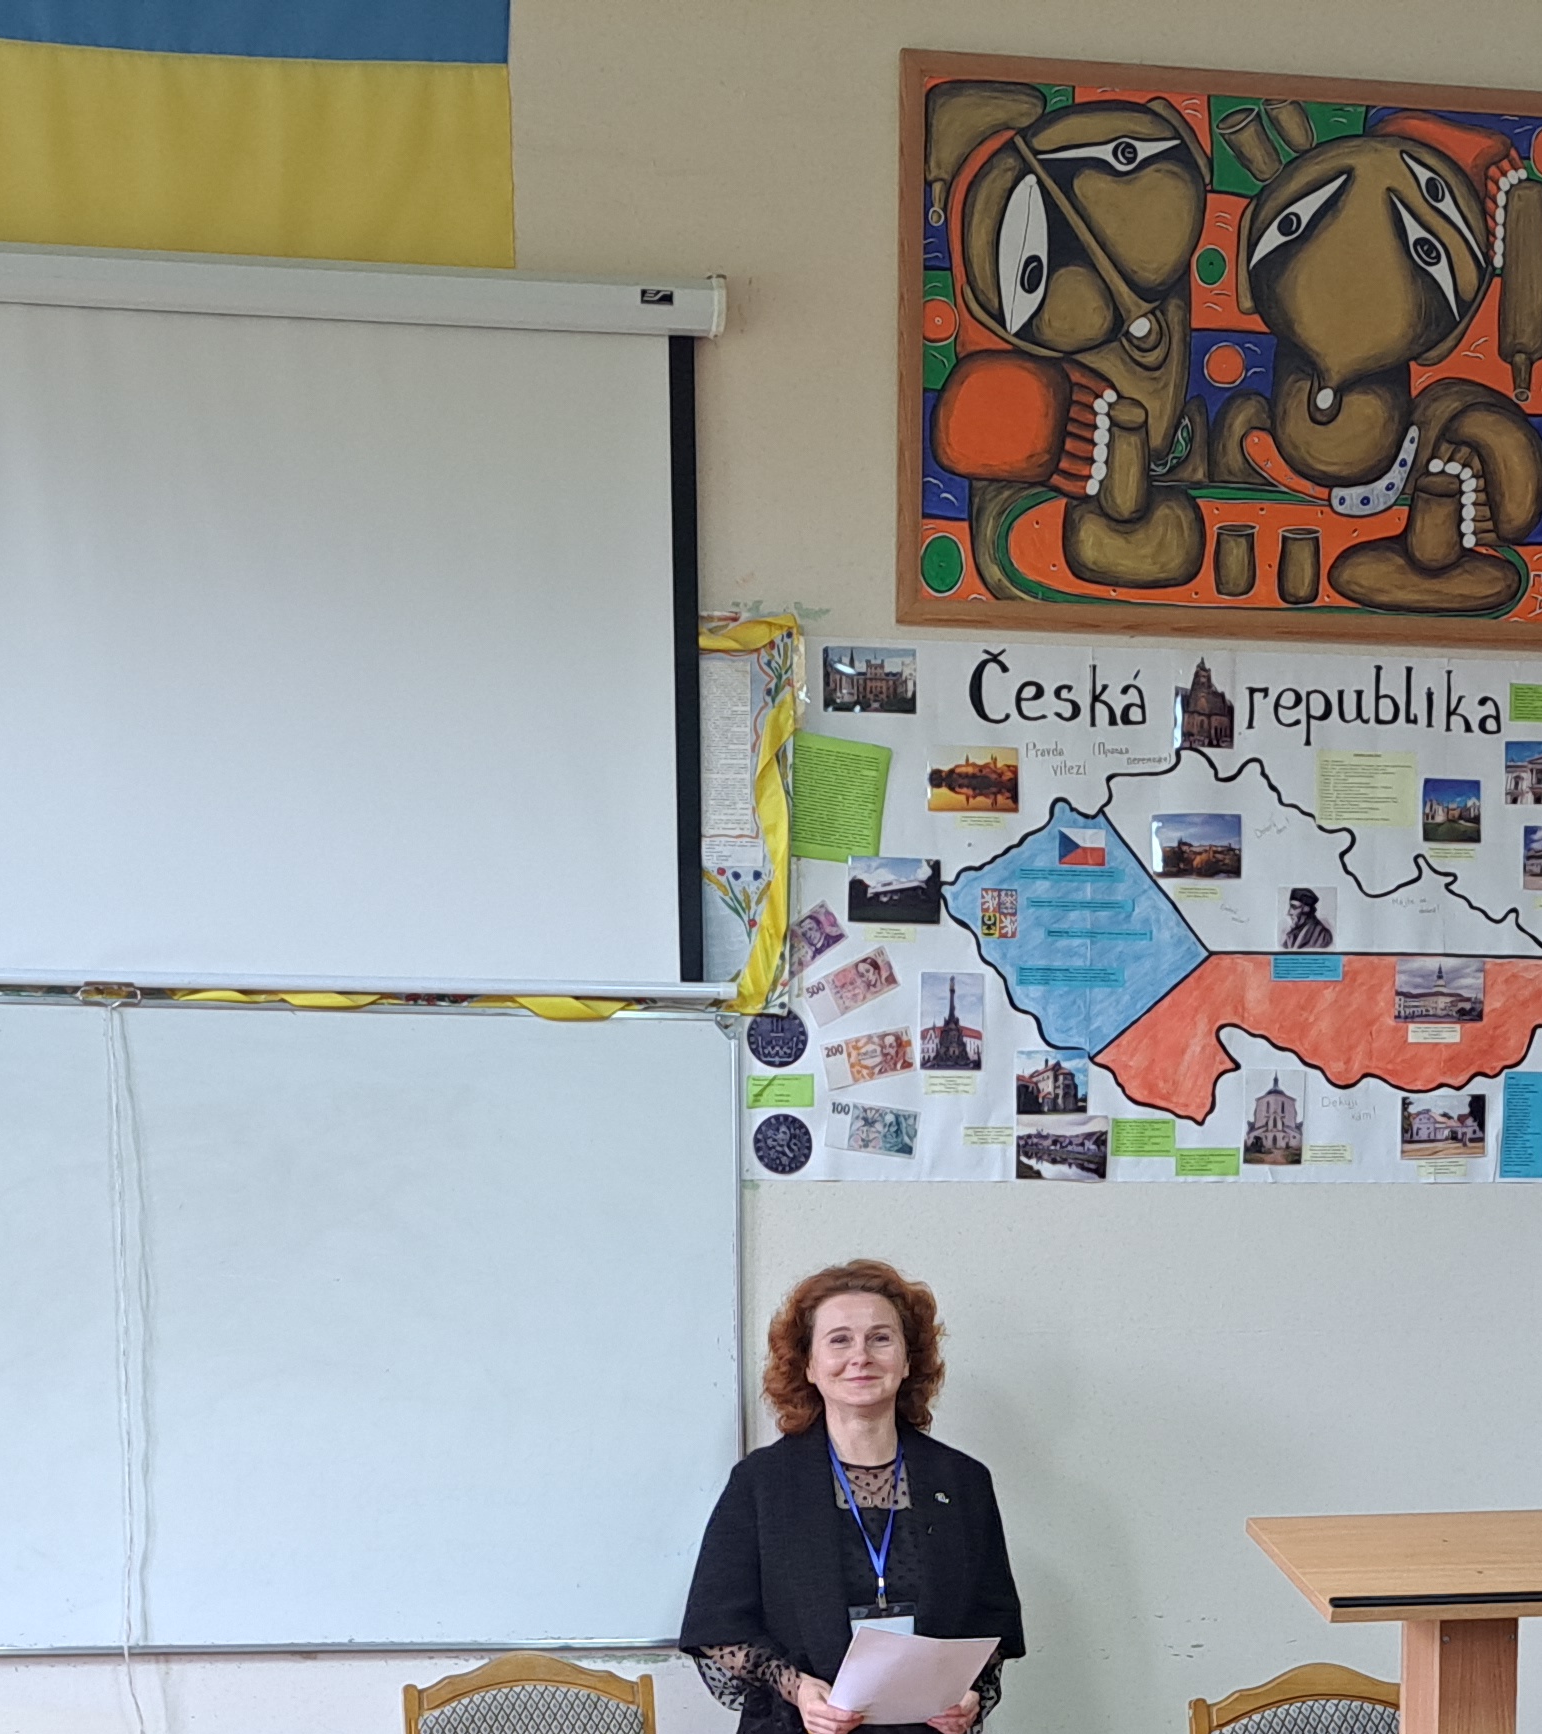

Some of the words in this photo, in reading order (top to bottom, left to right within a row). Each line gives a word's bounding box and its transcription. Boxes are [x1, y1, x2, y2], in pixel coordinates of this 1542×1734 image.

[969, 648, 1147, 728] Česká
[1245, 665, 1502, 746] republika
[805, 982, 826, 998] 500
[825, 1044, 844, 1058] 200
[831, 1102, 850, 1115] 100
